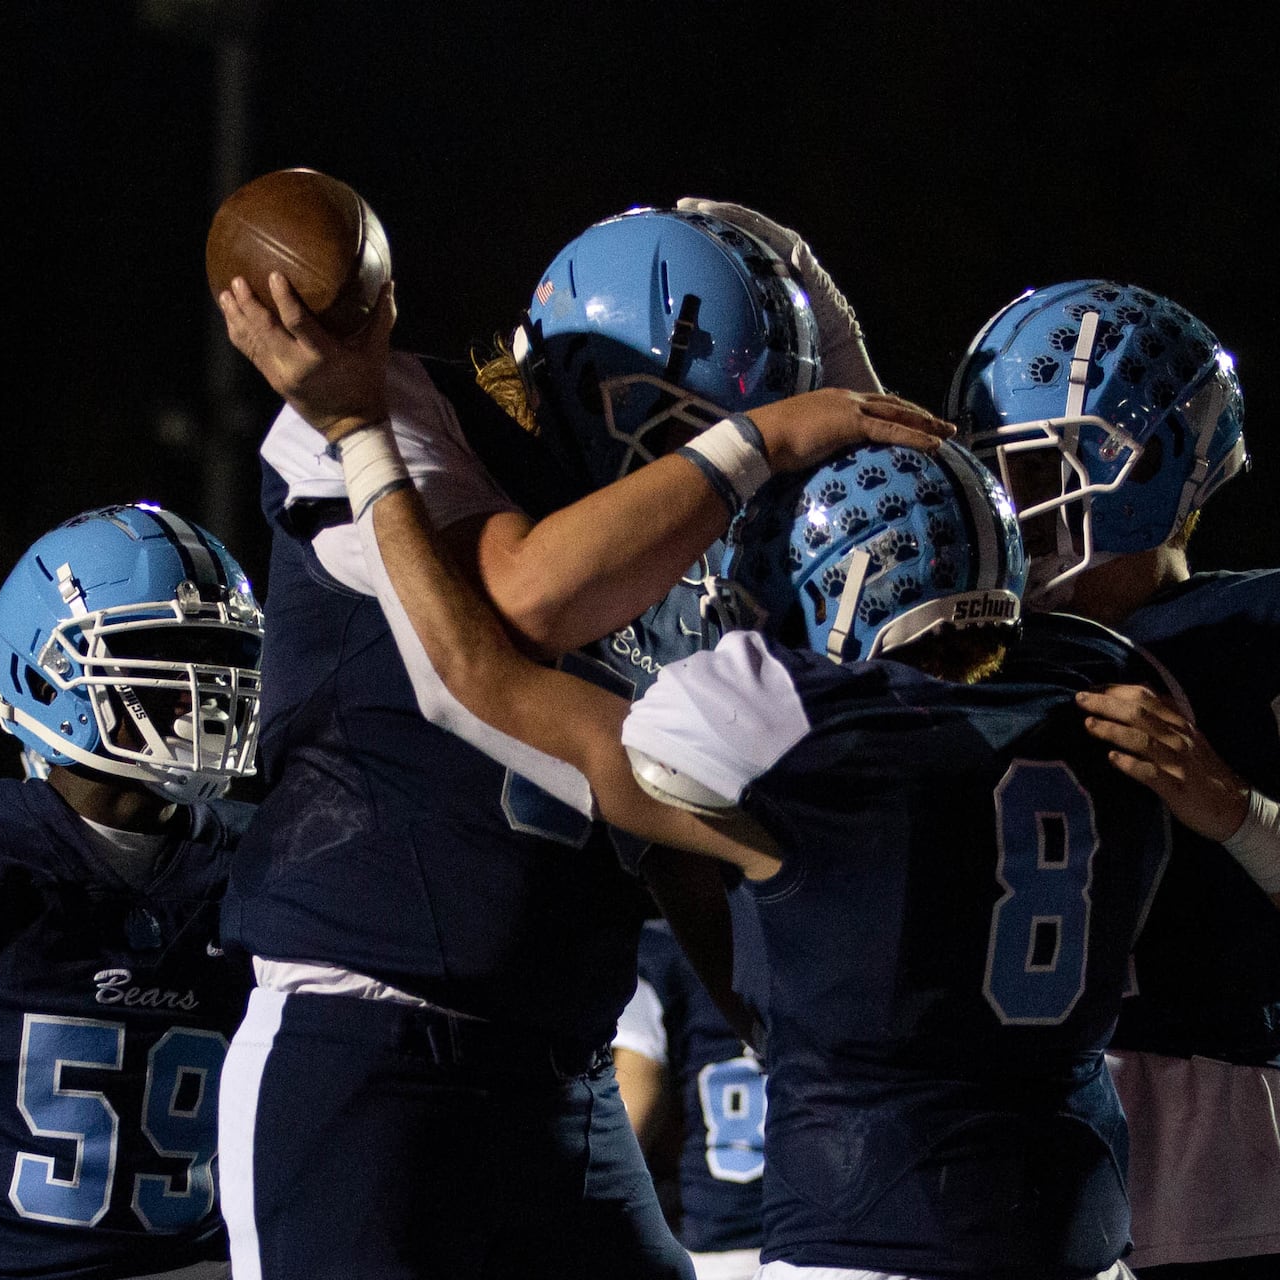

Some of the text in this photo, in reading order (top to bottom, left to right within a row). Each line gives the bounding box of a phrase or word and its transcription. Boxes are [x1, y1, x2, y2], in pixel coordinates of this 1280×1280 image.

[613, 625, 663, 675] Bear
[120, 684, 147, 720] schut
[981, 758, 1100, 1026] 8
[94, 968, 199, 1010] Bears
[8, 1012, 231, 1235] 59
